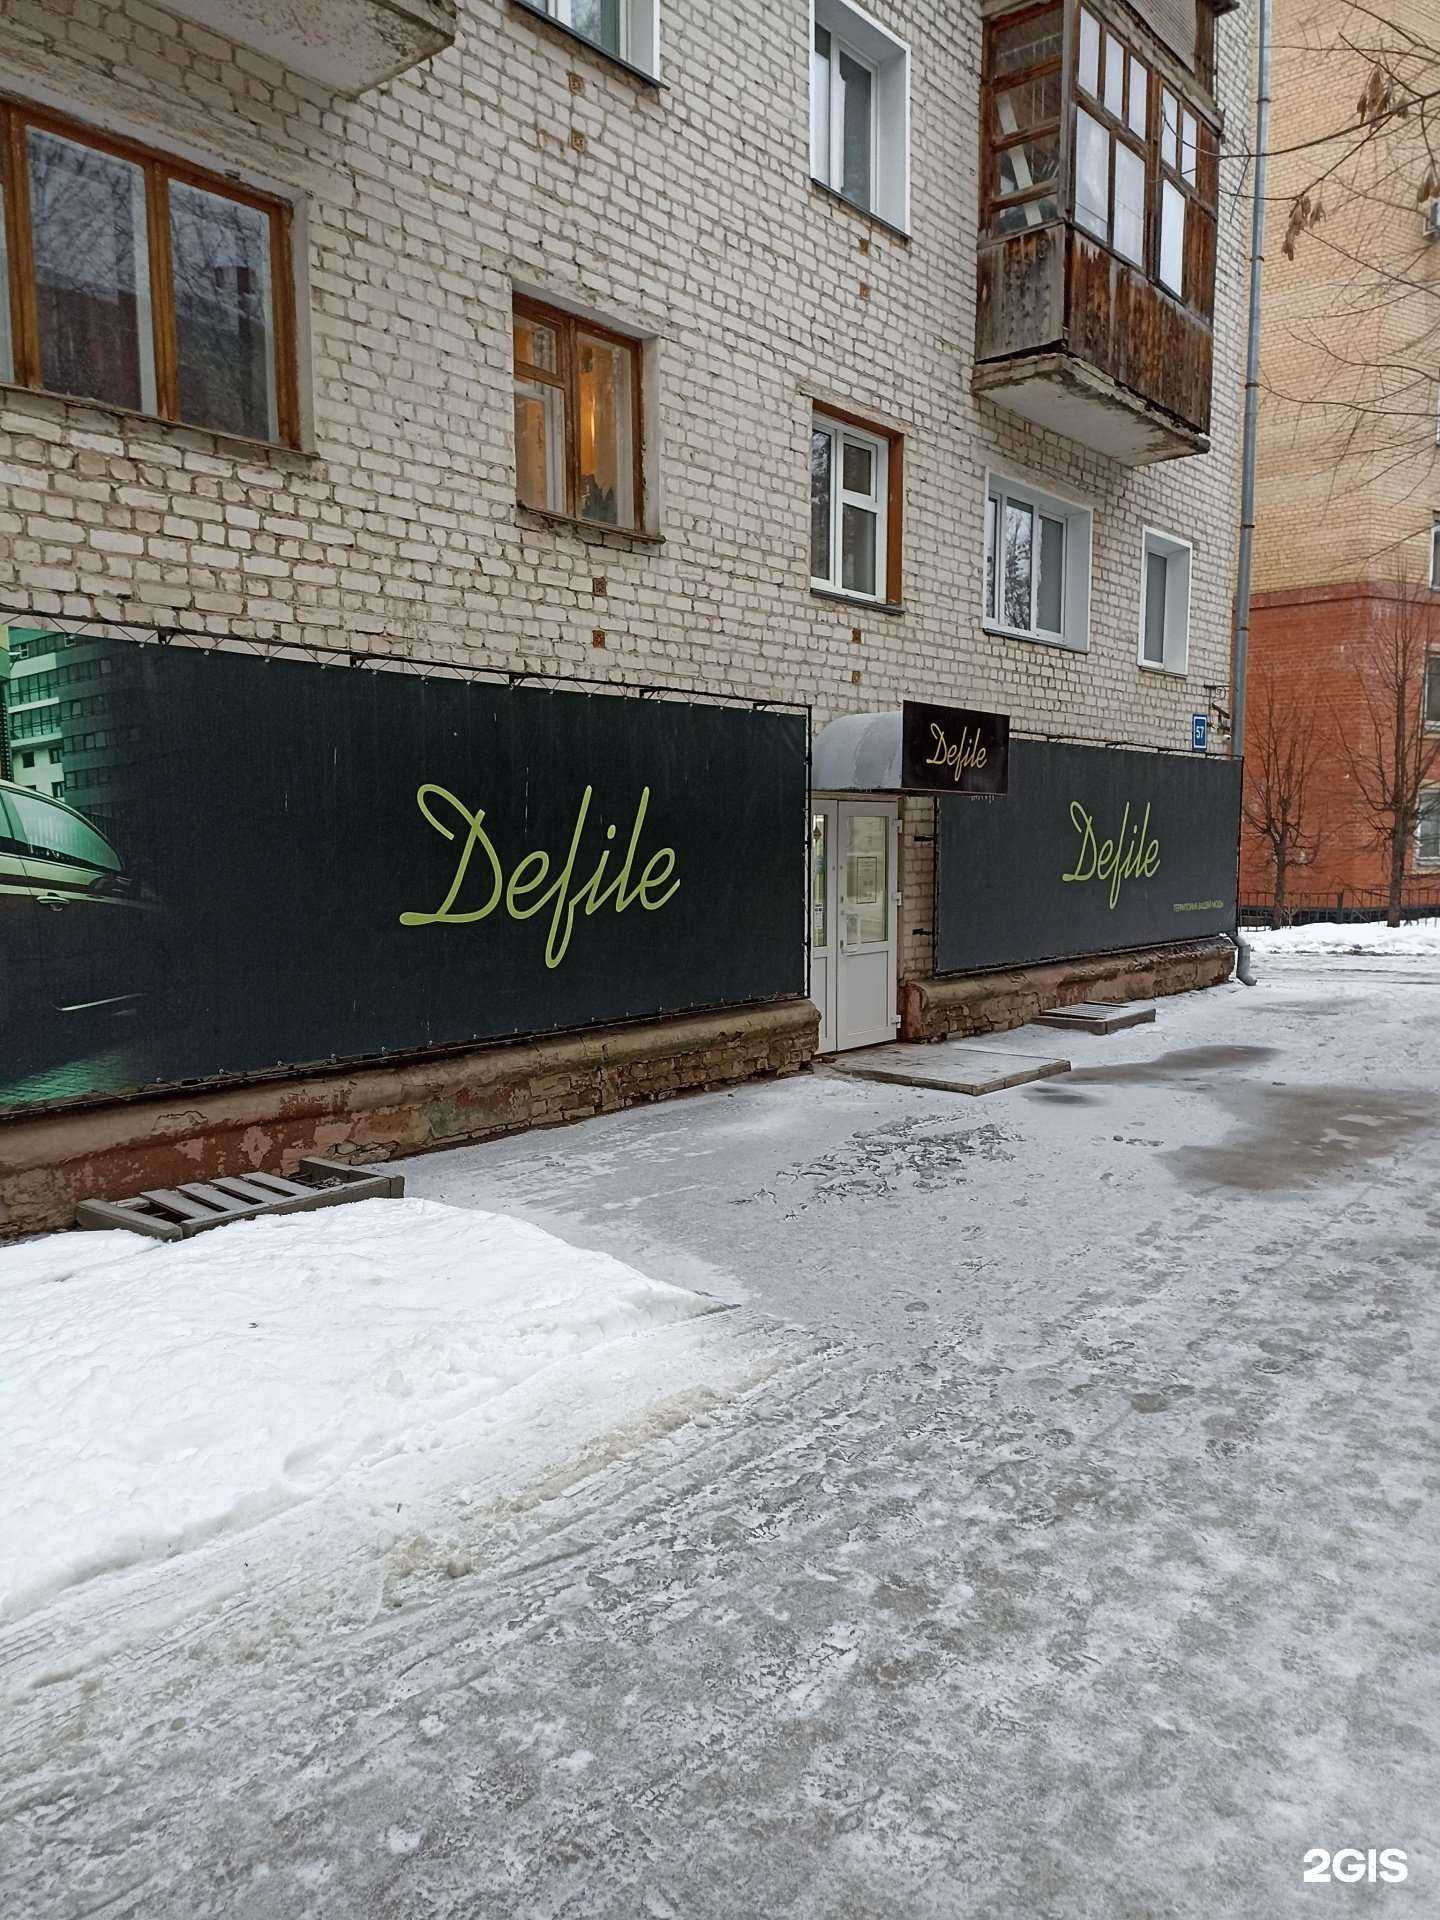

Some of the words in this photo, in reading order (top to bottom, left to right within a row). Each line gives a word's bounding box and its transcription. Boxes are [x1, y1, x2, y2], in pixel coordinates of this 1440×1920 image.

[926, 723, 988, 781] Defile
[1195, 726, 1204, 739] 57
[399, 783, 681, 969] Defile
[1062, 801, 1160, 910] Defile
